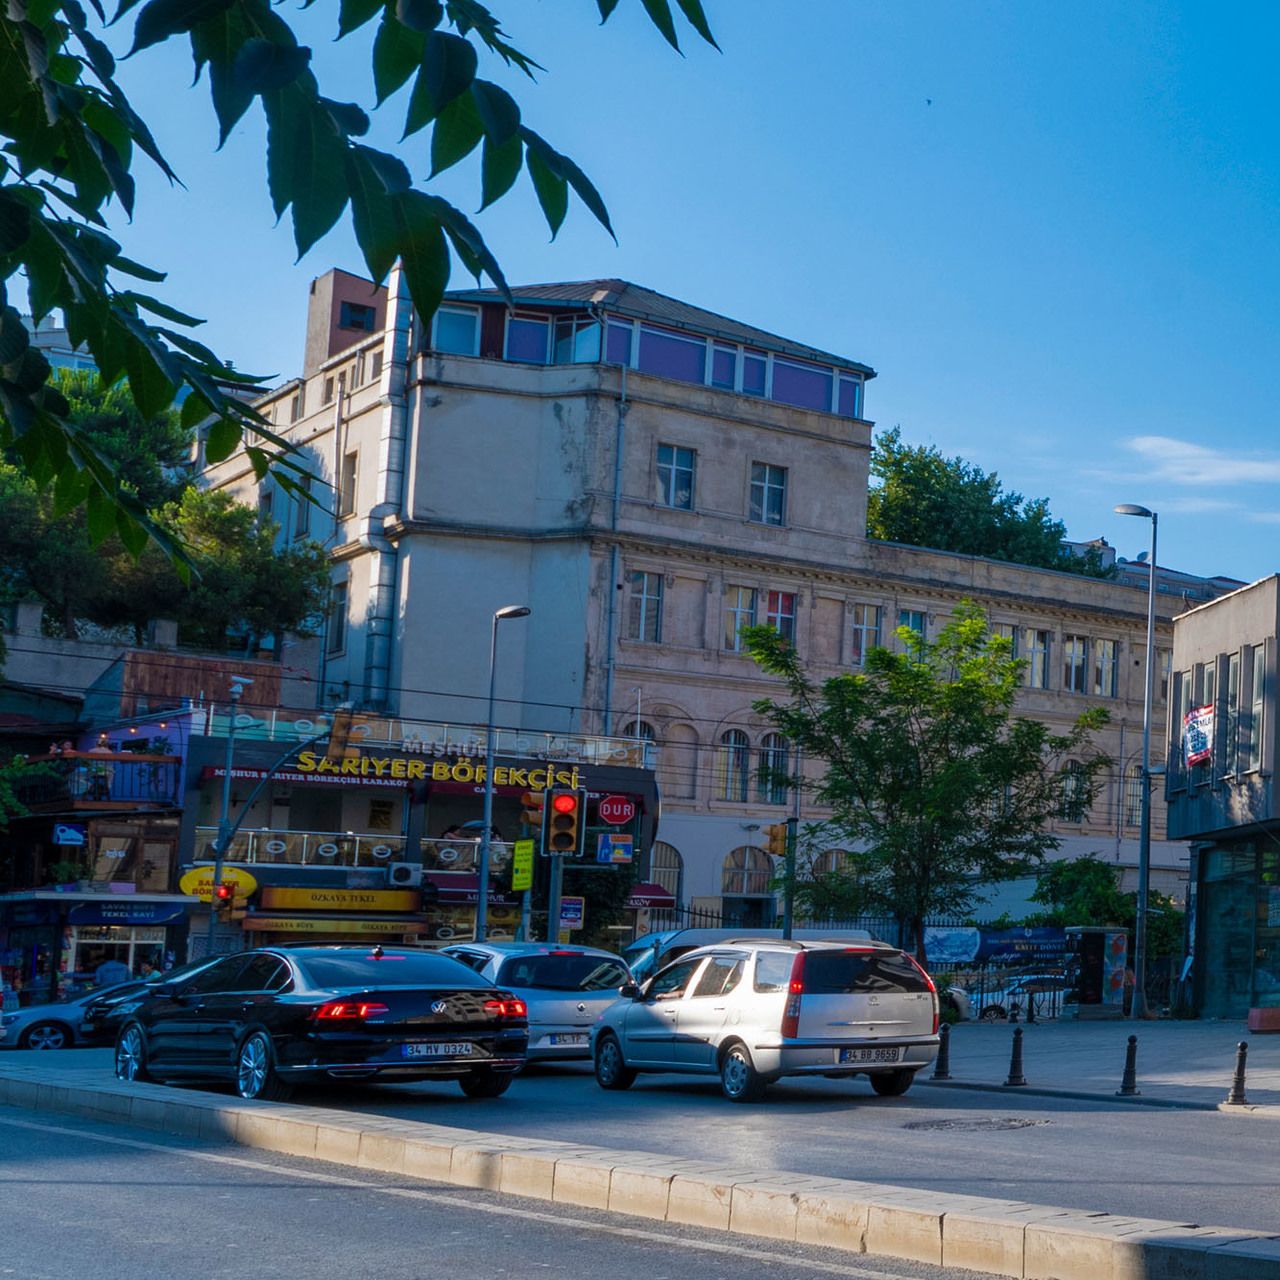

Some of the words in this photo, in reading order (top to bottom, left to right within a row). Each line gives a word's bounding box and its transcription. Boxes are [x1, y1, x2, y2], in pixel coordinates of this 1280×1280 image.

[296, 751, 426, 780] SARIYER
[261, 772, 305, 782] SRIYER
[474, 786, 498, 794] CAE
[602, 803, 633, 817] DUR
[349, 894, 376, 903] TEKEL
[407, 1044, 422, 1056] 34
[443, 1042, 471, 1055] 0324
[847, 1049, 857, 1059] 34
